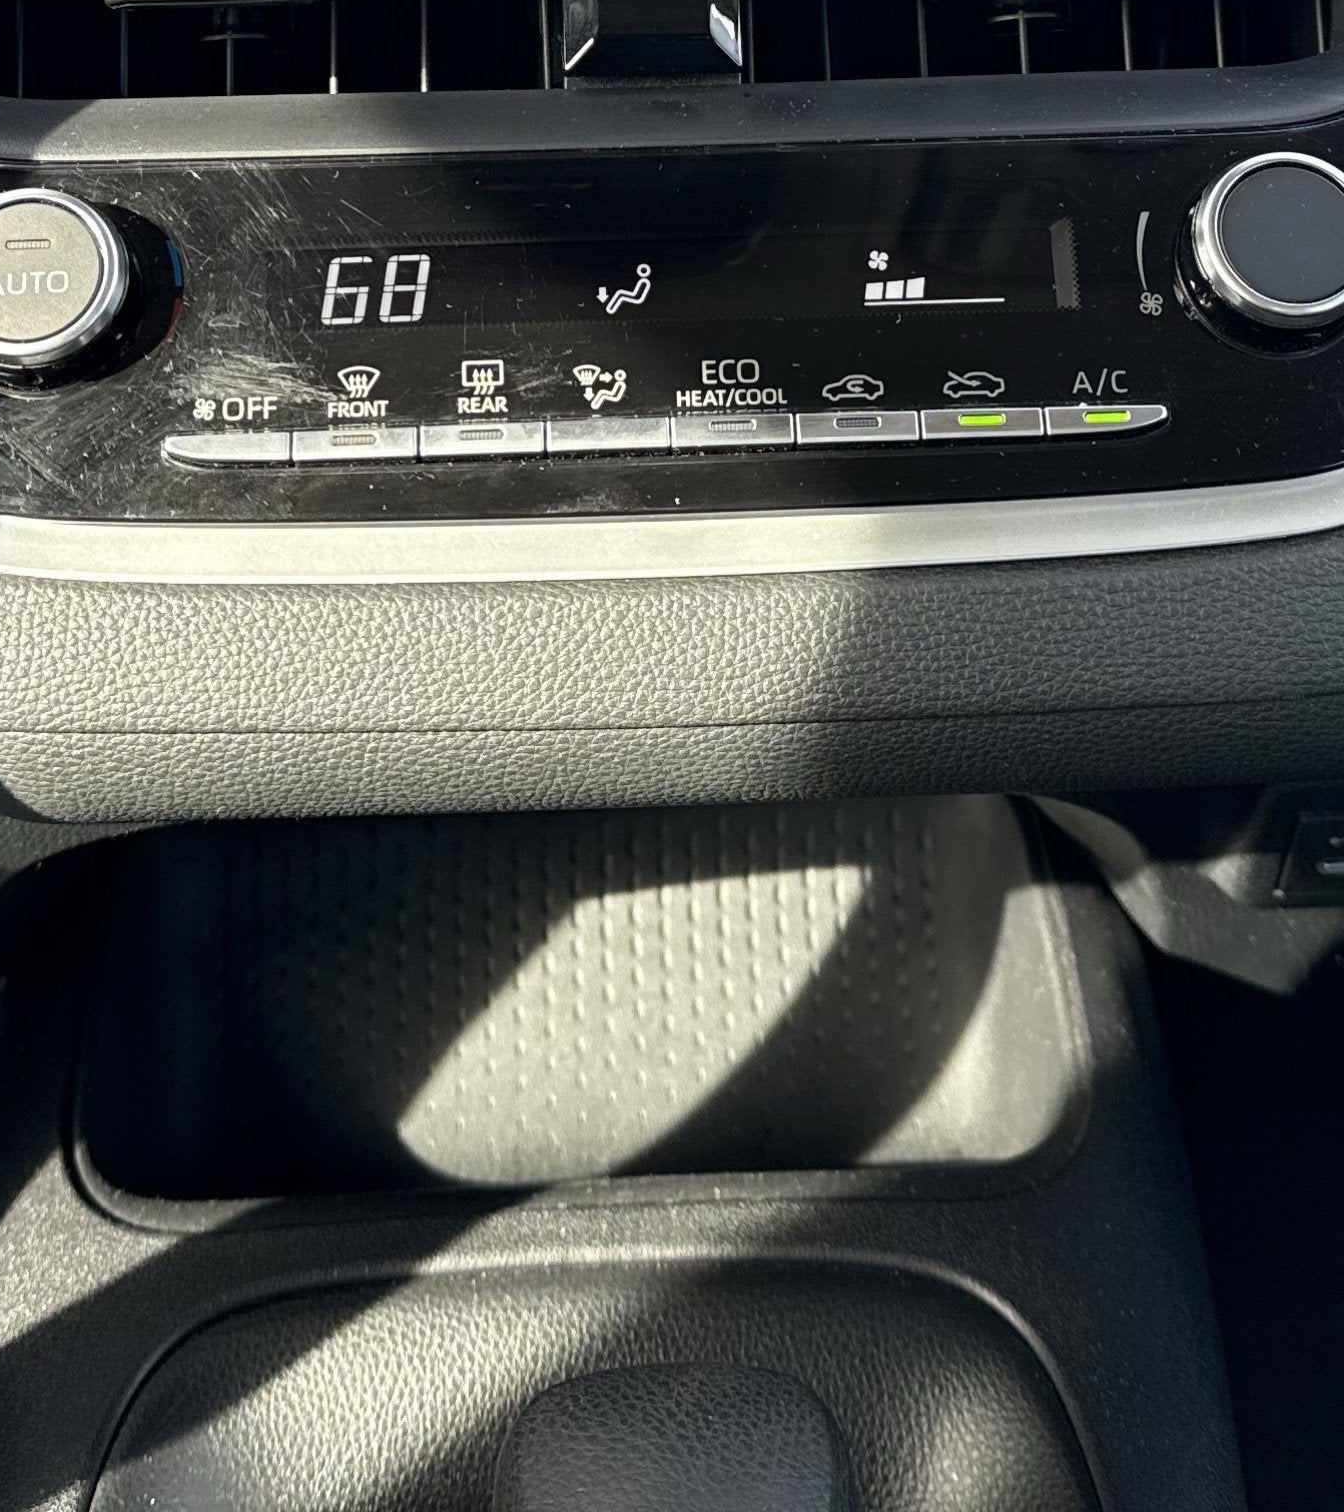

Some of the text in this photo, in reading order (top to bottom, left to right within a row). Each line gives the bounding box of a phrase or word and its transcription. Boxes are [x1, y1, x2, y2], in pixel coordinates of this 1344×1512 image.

[320, 254, 432, 326] 68
[701, 358, 760, 385] ECO
[1071, 368, 1129, 397] A/C
[221, 396, 279, 421] OFF
[327, 399, 389, 419] FRONT
[457, 396, 509, 415] REAR
[675, 388, 788, 408] HEAT/COOL
